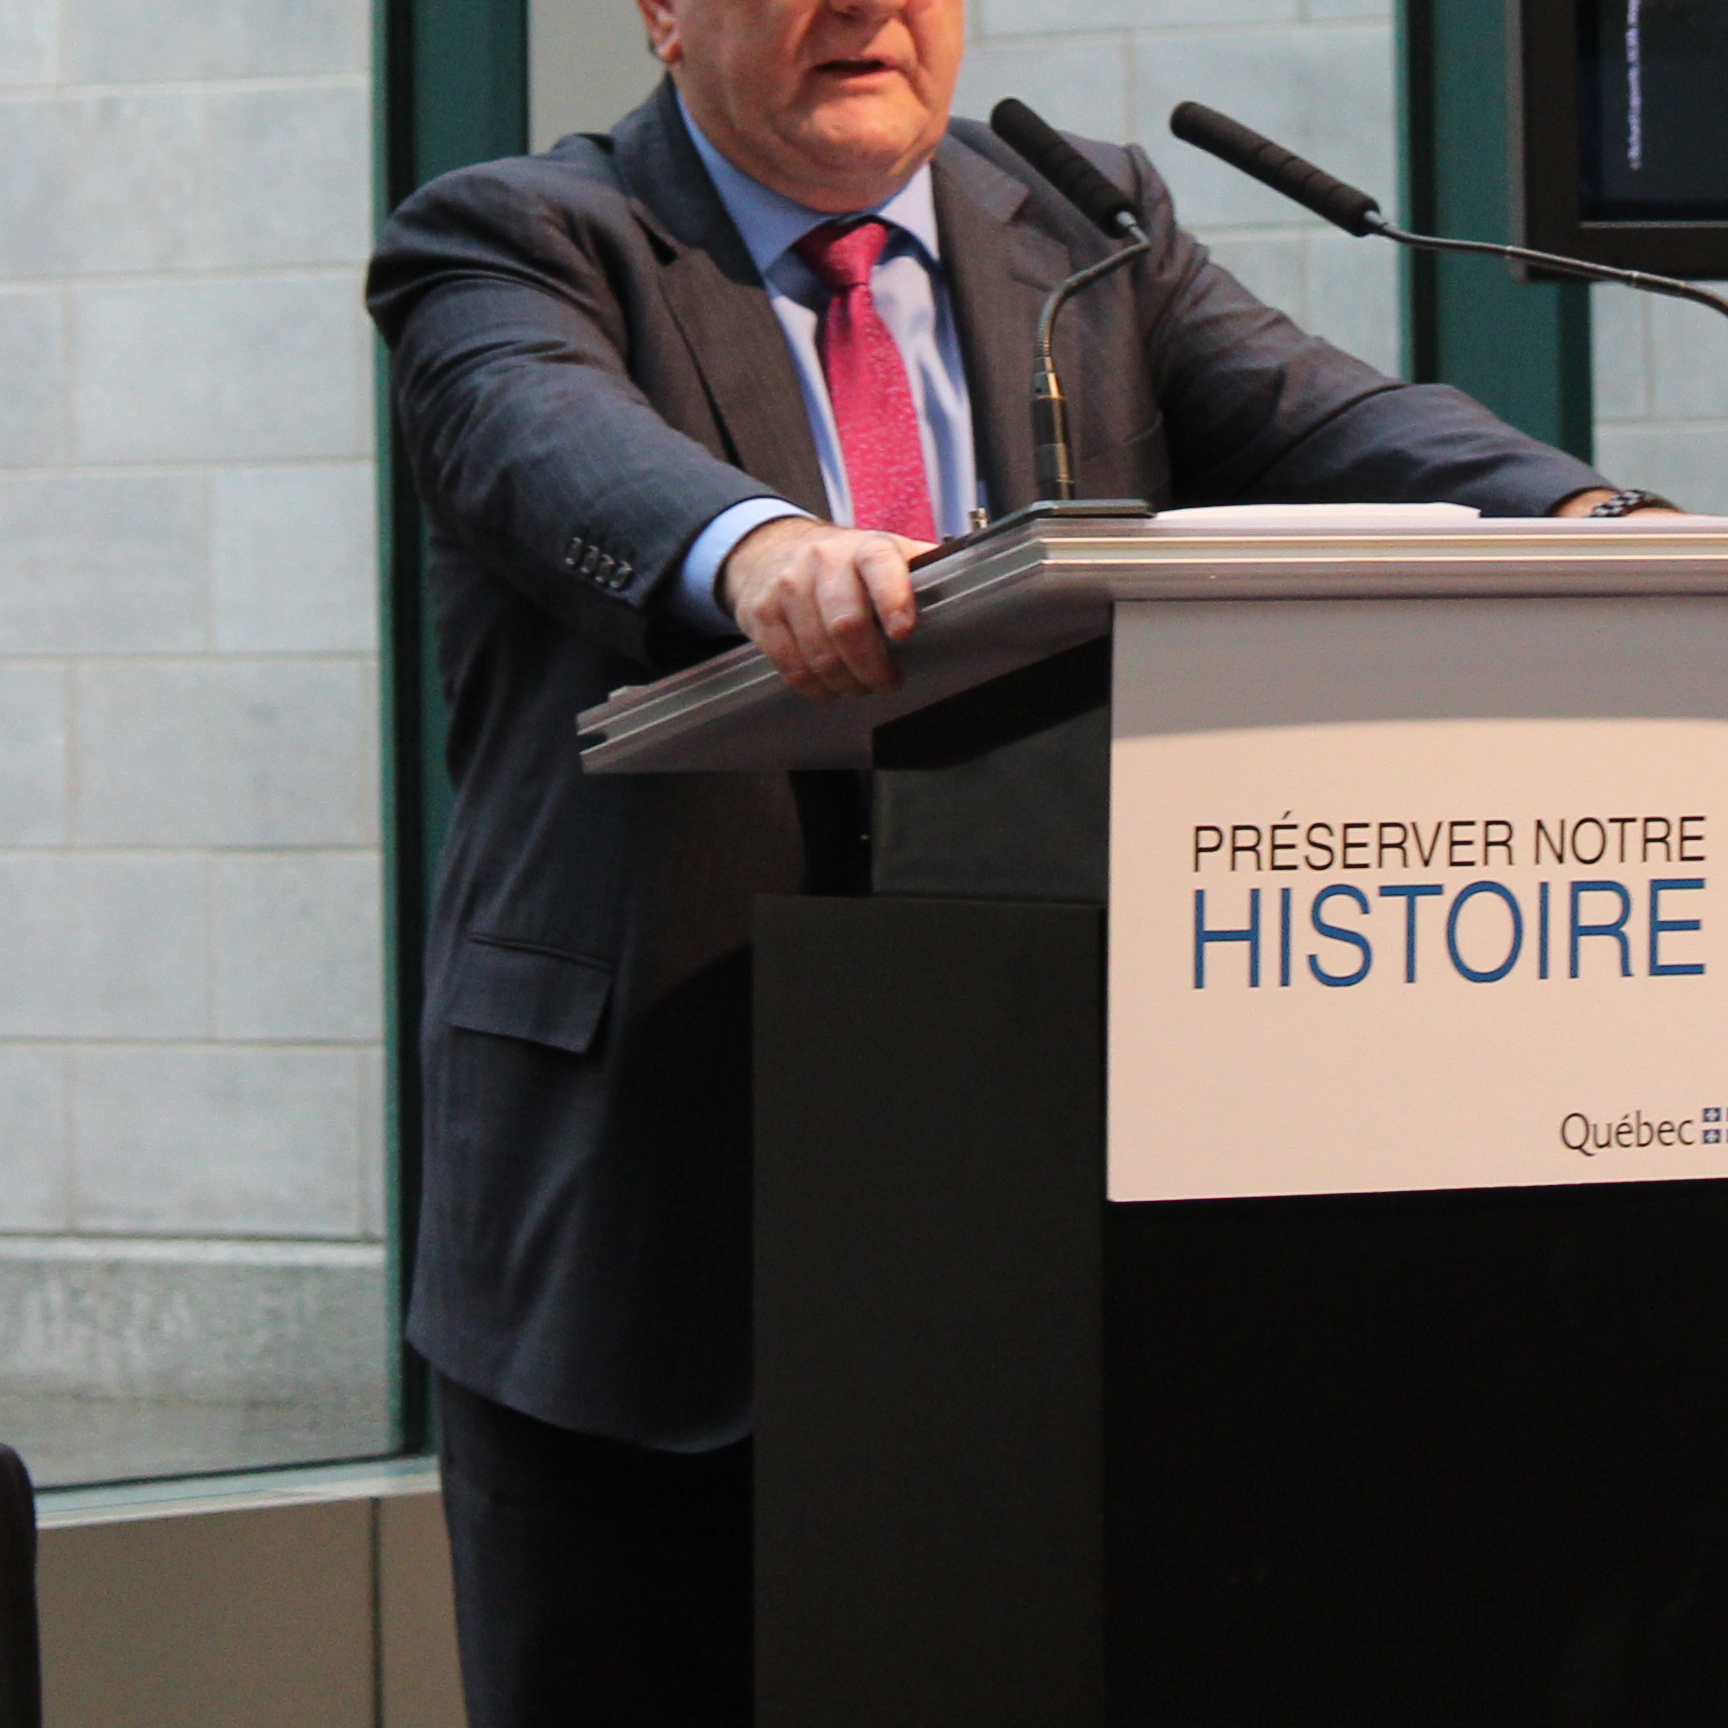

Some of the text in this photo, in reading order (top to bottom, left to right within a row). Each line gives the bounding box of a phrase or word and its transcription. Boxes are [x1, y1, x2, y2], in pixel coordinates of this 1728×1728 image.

[1193, 810, 1707, 872] PRÉSERVER NOTRE
[1193, 878, 1706, 989] HISTOIRE
[1561, 1110, 1695, 1157] Québec
